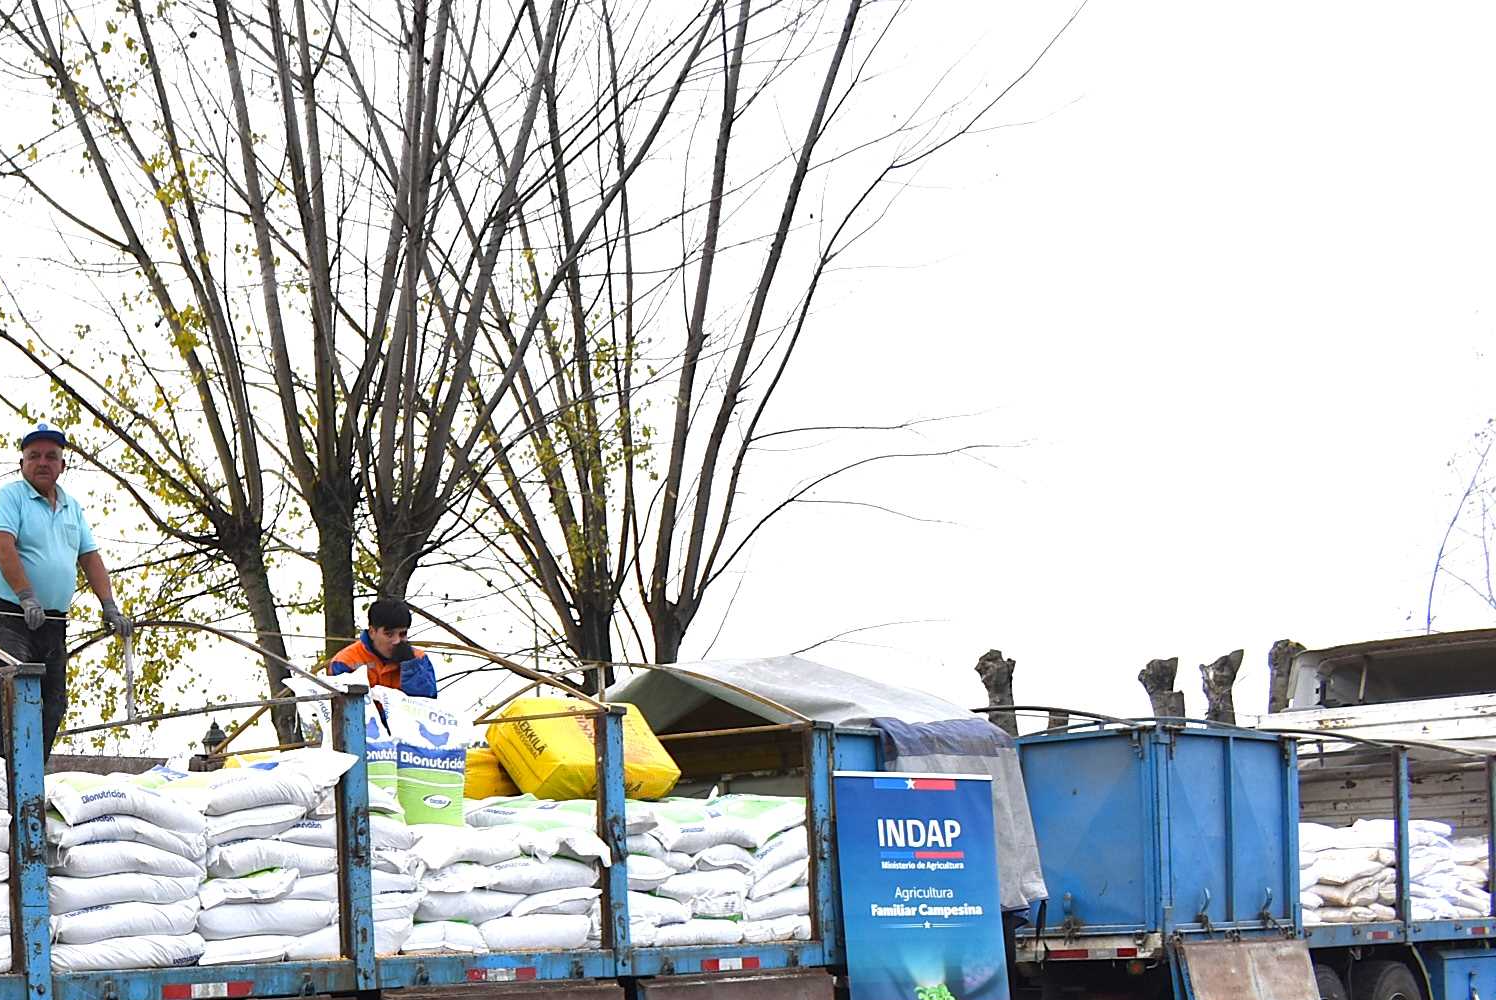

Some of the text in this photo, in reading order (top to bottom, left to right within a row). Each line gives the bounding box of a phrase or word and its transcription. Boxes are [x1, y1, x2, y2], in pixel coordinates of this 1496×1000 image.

[877, 818, 961, 848] INDAP
[881, 861, 964, 871] Ministerio de Agricultura
[894, 886, 954, 902] Agricultura
[870, 903, 983, 919] Familiar Campesina
